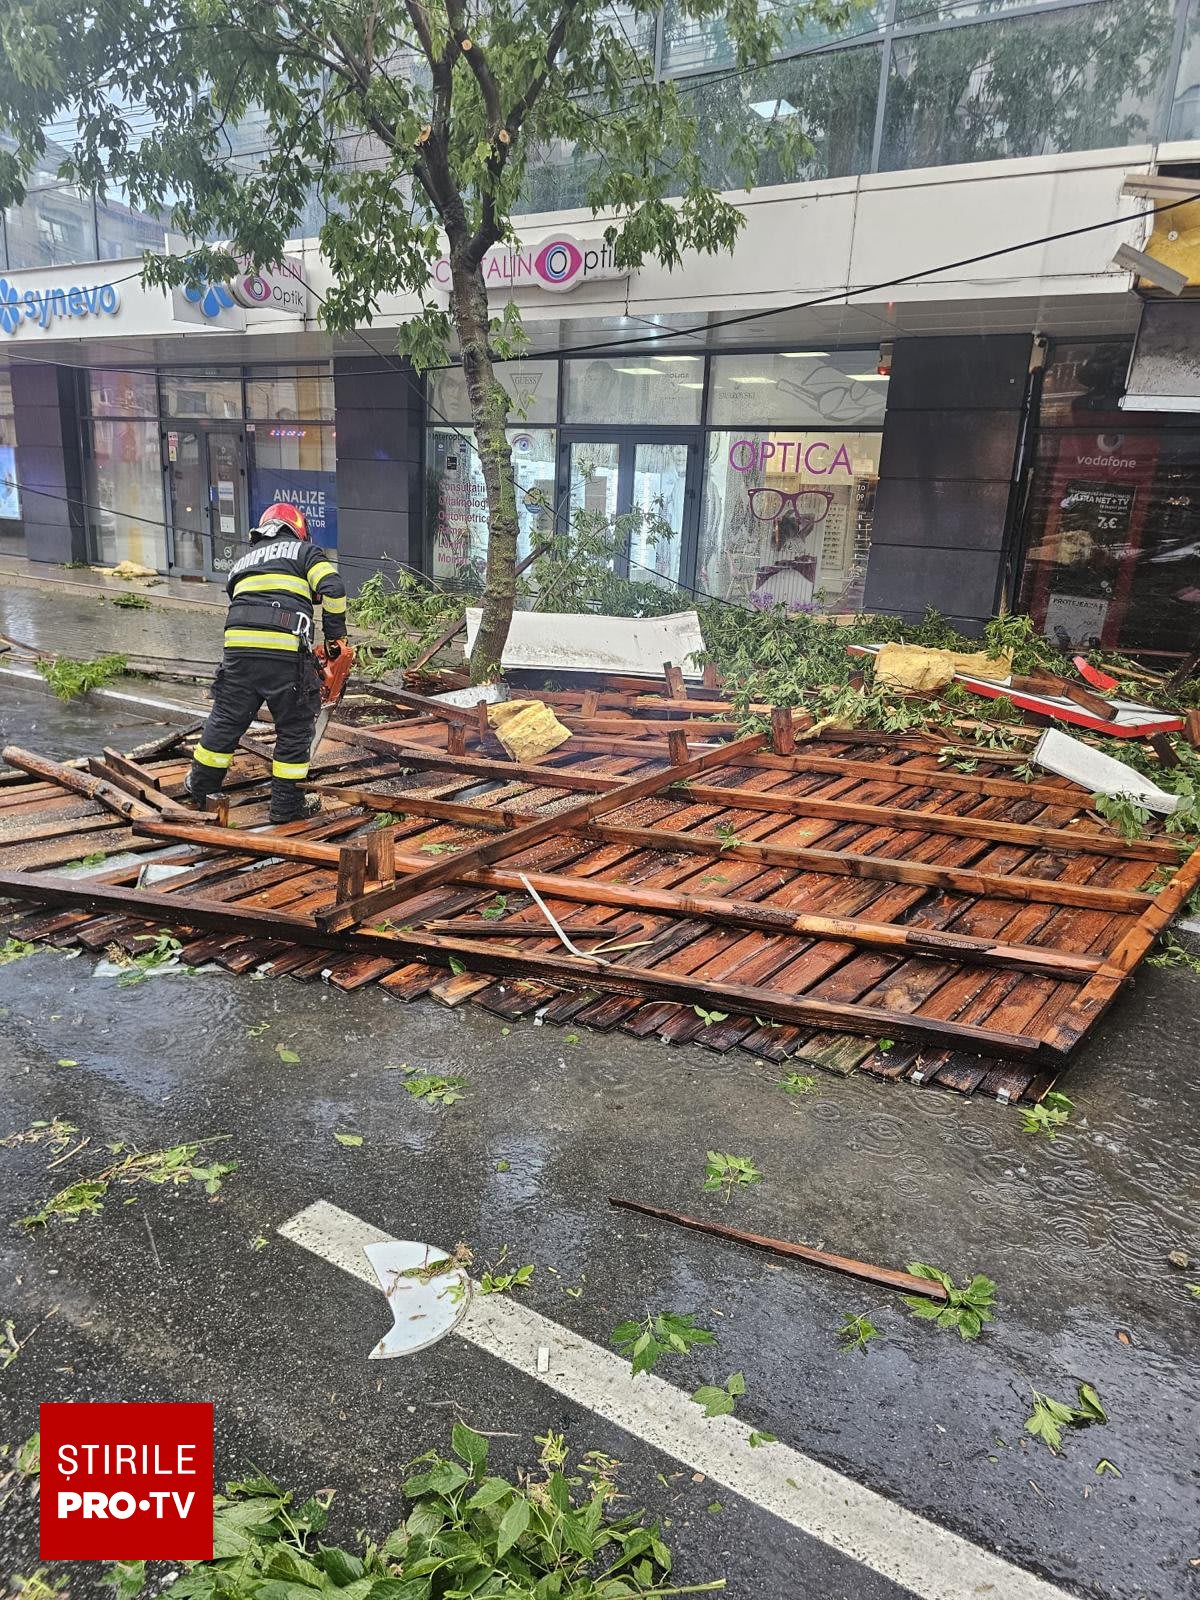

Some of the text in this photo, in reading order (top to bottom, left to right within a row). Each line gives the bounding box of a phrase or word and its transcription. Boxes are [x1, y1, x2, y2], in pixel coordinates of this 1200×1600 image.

[436, 253, 532, 283] CALIN
[24, 284, 118, 328] synevo
[272, 285, 303, 306] Optik
[514, 377, 537, 385] GUESS
[729, 440, 853, 475] OPTICA
[1077, 456, 1137, 468] vodafone
[273, 489, 326, 505] ANALIZE
